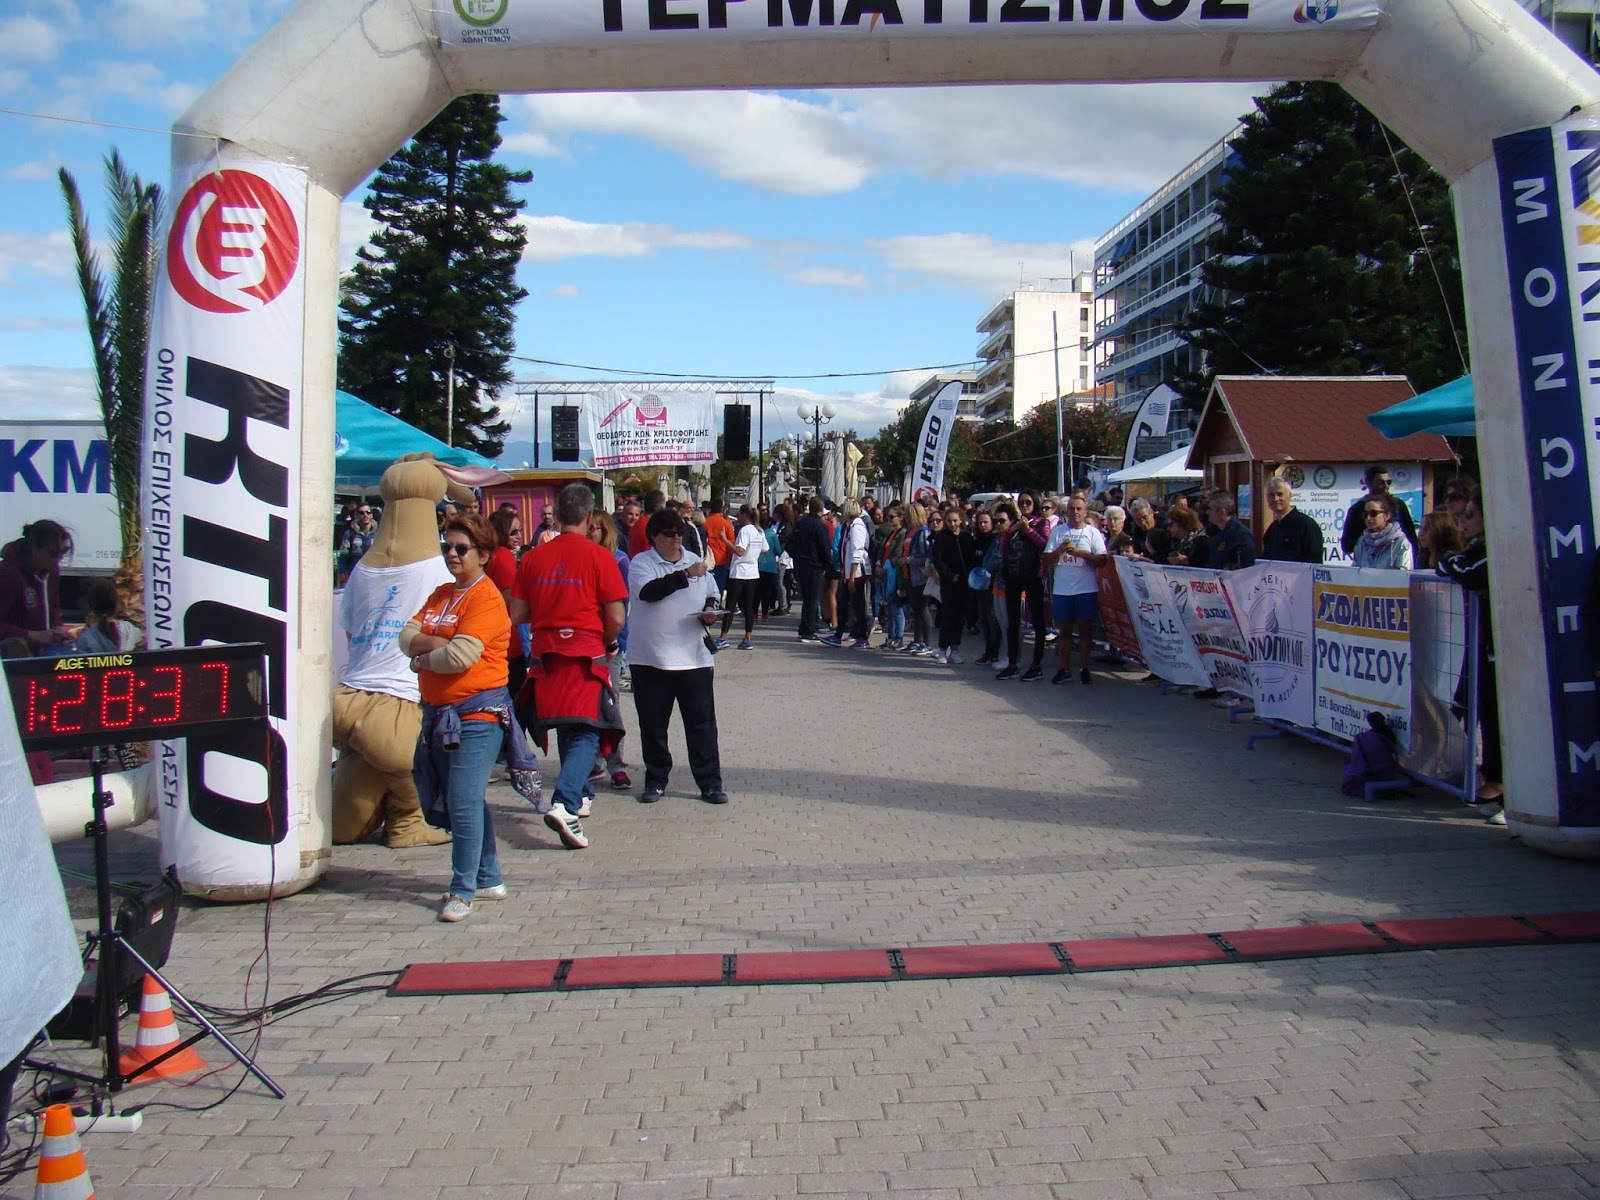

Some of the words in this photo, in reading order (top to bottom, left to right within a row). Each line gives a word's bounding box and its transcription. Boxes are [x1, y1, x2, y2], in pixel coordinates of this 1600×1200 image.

[461, 28, 510, 37] ΟΡΓΑΝΙΣΜΟΣ
[153, 347, 175, 443] ΟΜΙΛΟΣ
[596, 430, 631, 440] ΘΕΟΔΩΡΟΣ
[653, 429, 709, 437] ΧΡΙΣΤΟΦΟΡΙΔΗΣ
[610, 438, 649, 446] ΗΧΗΤΙΚΕΣ
[1320, 522, 1333, 531] ΟΥ
[1334, 508, 1345, 531] 8
[151, 451, 173, 631] ΕΠΙΧΕΙΡΗΣΕΩΝ
[96, 550, 108, 559] 216
[54, 654, 134, 671] ALGE-TIMING
[1316, 638, 1408, 687] ΡΟΥΣΣΟΥ
[27, 663, 230, 734] 1:28:37
